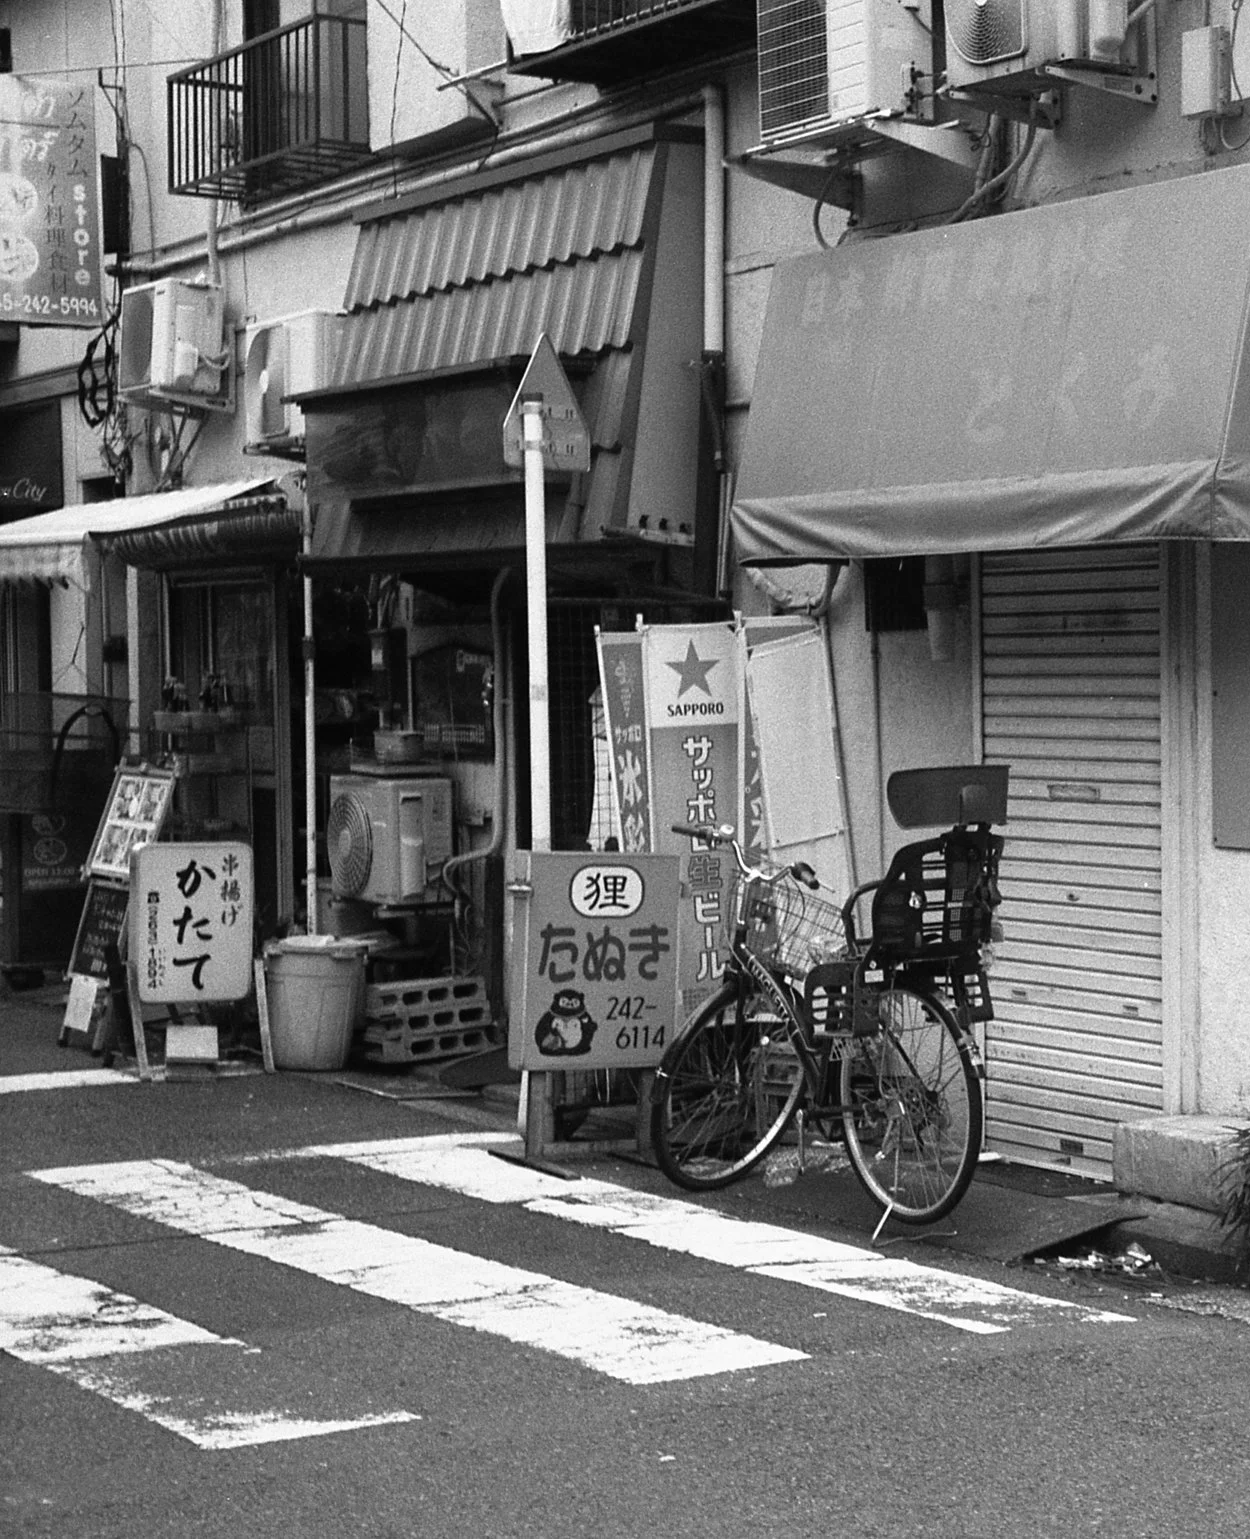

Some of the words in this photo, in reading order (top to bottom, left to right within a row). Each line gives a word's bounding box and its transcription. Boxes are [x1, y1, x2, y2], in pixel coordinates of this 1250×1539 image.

[66, 91, 88, 177] ソムタム
[73, 184, 90, 285] store
[0, 292, 98, 317] 5-242-5994
[667, 702, 724, 717] SAPPORO
[583, 872, 631, 911] 狸
[173, 860, 217, 990] かたて
[538, 922, 671, 983] たぬき
[606, 996, 657, 1021] 242-
[615, 1025, 666, 1050] 6114
